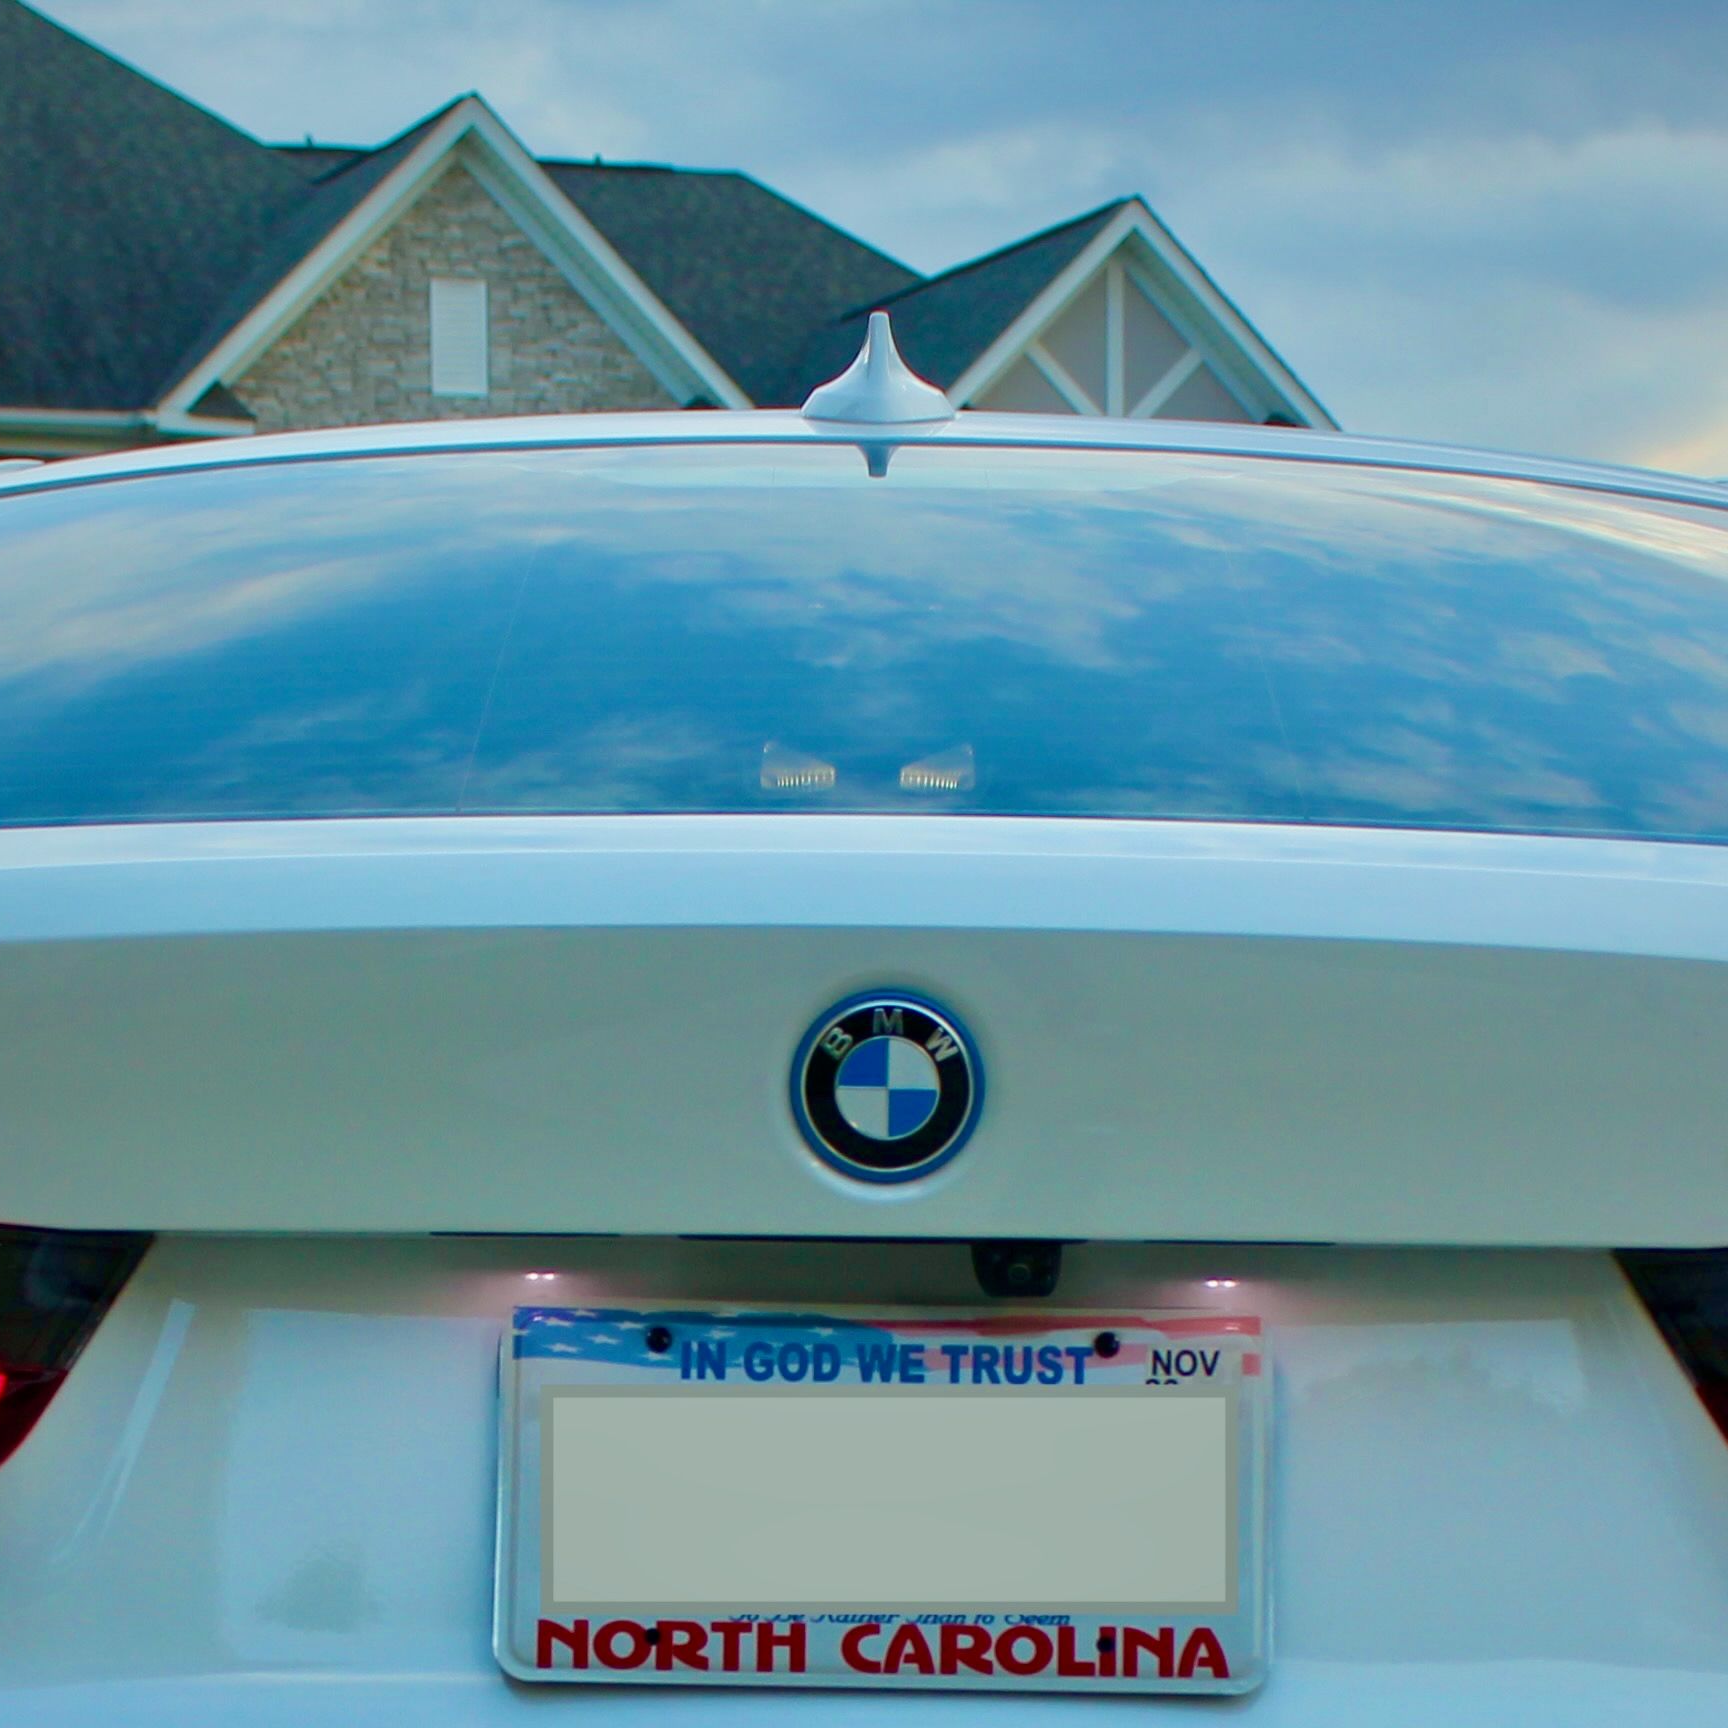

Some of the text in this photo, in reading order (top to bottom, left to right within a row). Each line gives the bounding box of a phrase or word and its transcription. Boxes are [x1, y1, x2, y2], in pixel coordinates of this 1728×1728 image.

[818, 1007, 959, 1062] BMW
[680, 1341, 1094, 1386] IN GOD WE TRUST
[1152, 1349, 1221, 1377] NOV
[535, 1618, 1230, 1679] NORTH CAROLINA
